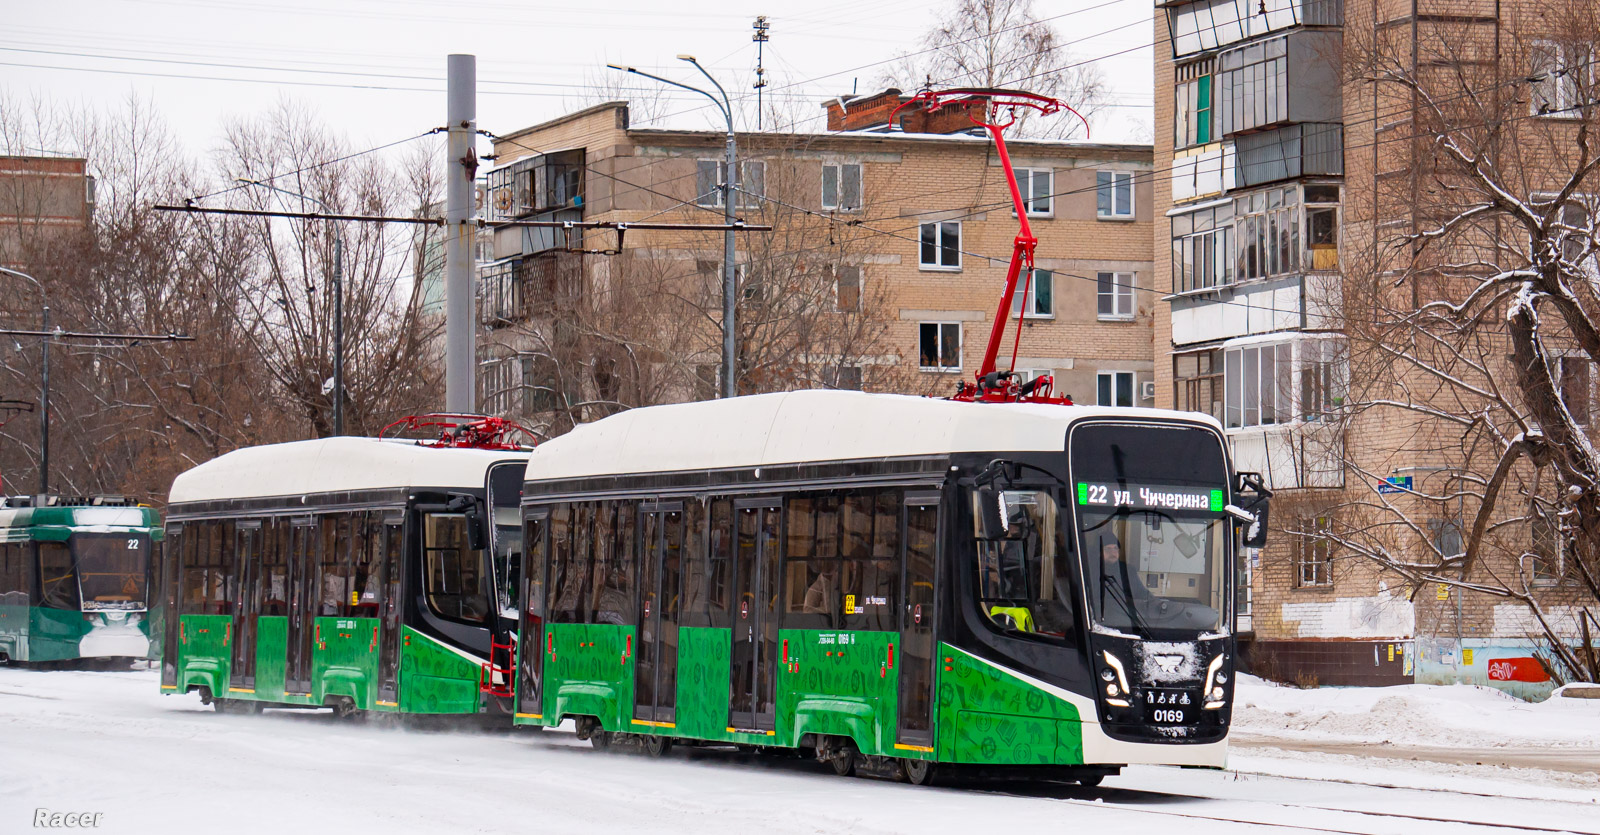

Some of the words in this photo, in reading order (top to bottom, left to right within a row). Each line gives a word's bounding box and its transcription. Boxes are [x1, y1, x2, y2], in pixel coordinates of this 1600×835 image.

[1088, 485, 1108, 503] 22
[1113, 490, 1135, 506] ул.
[1139, 487, 1209, 509] Чичерина
[127, 539, 139, 550] 22
[846, 595, 854, 612] 22
[1153, 709, 1184, 722] 0169
